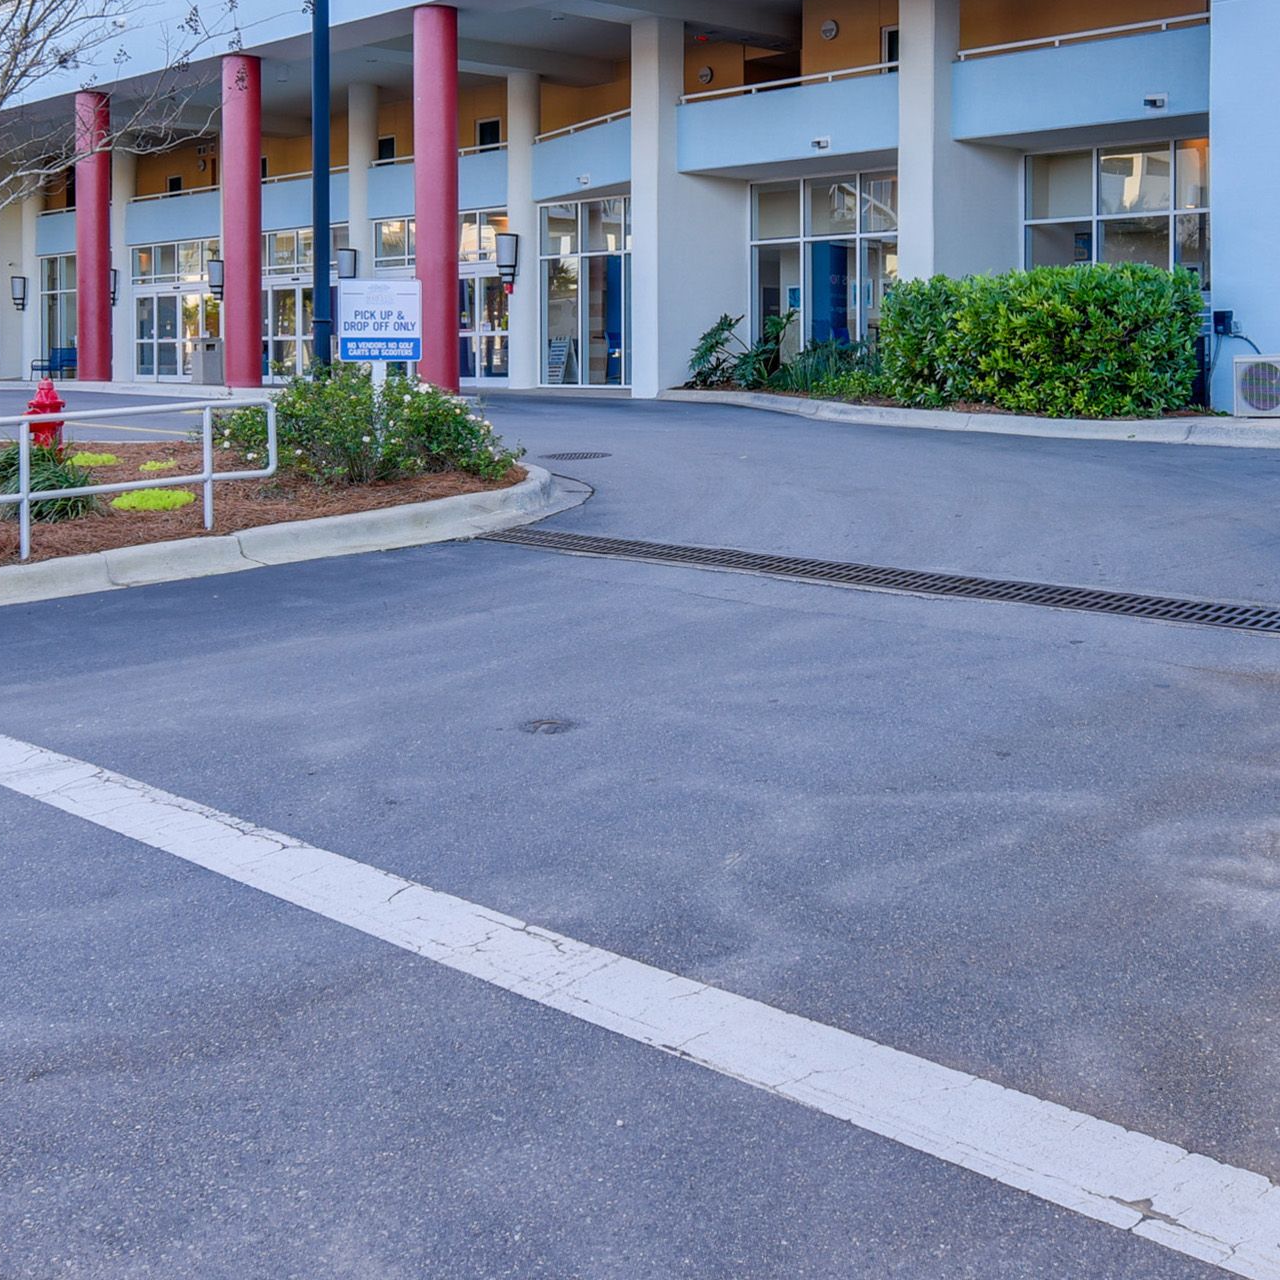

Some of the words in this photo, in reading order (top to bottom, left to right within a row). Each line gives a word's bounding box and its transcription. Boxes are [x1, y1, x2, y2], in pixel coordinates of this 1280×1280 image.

[354, 310, 376, 320] PICK
[380, 310, 393, 320] UP
[396, 310, 405, 320] &
[343, 321, 370, 332] DROP
[372, 321, 390, 332] OFF
[393, 321, 417, 332] ONLY
